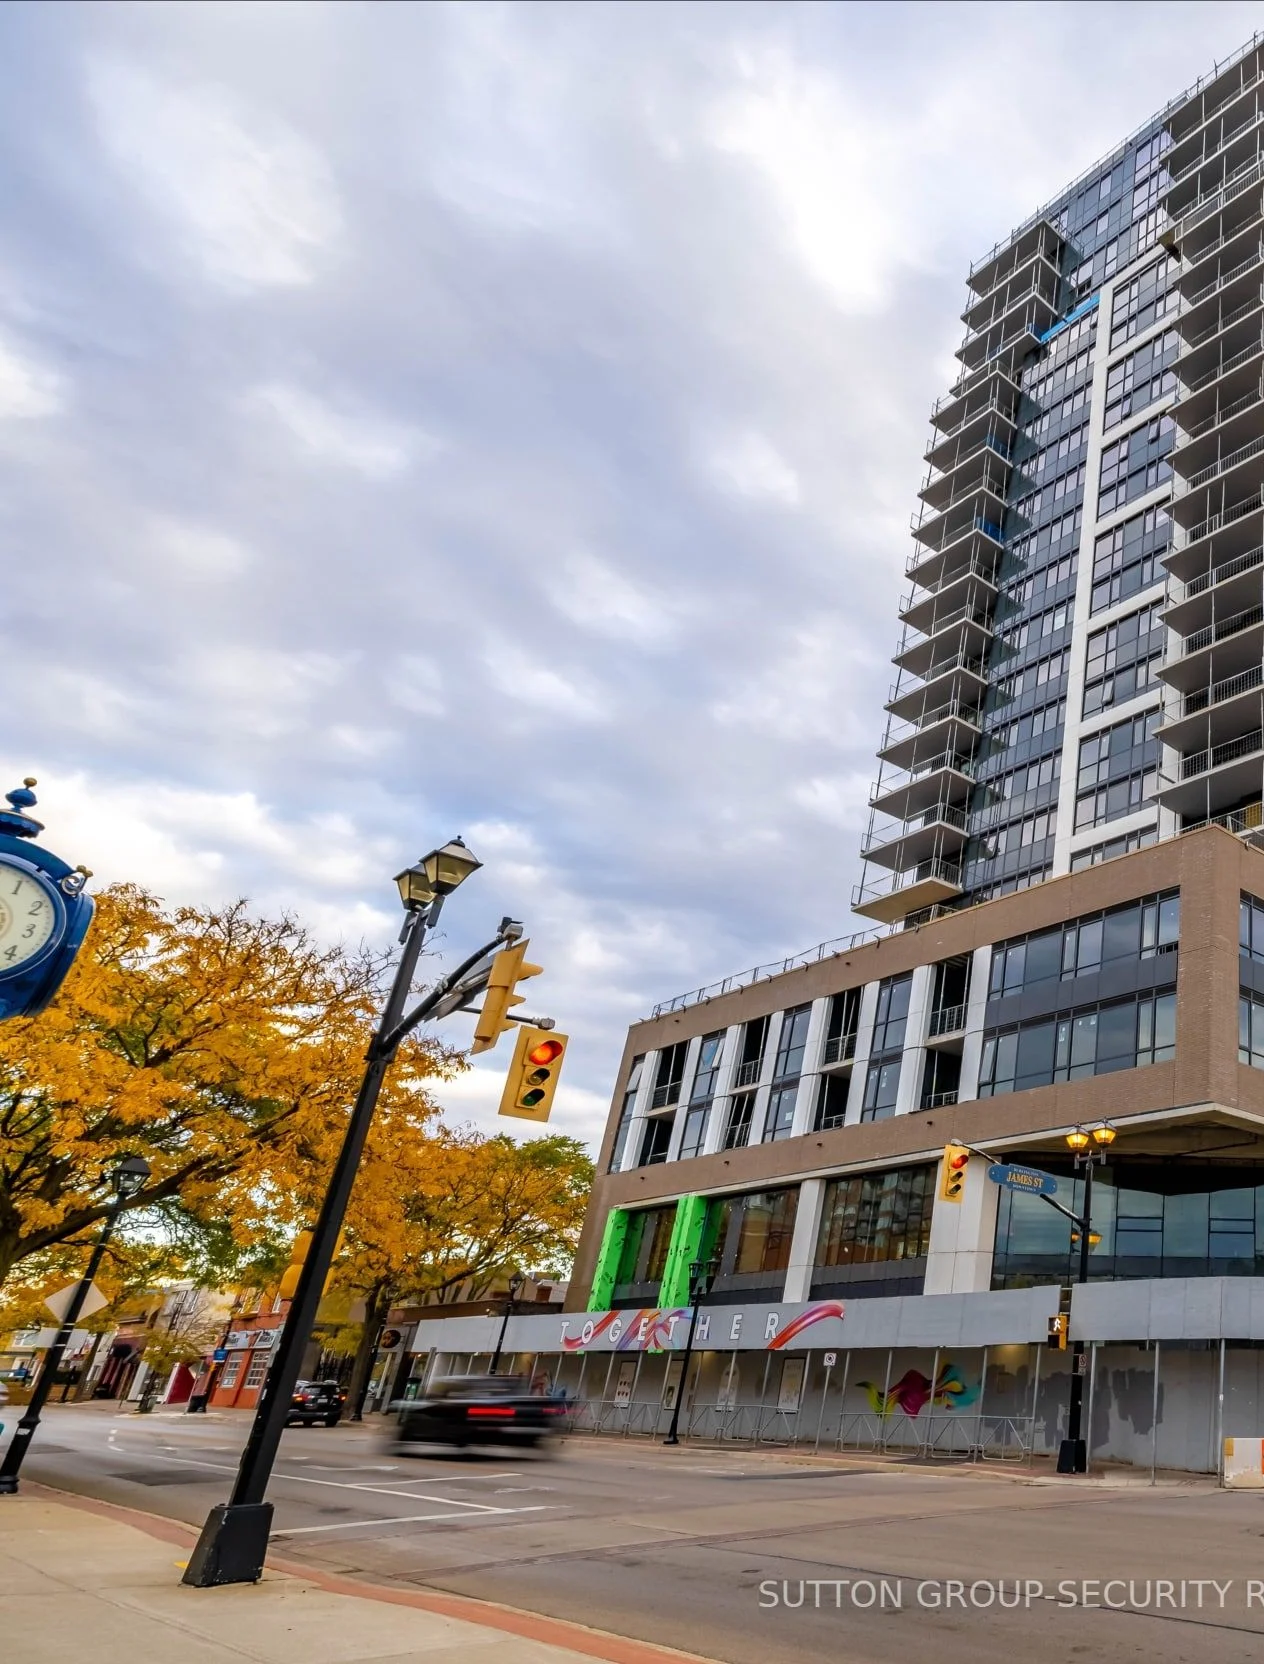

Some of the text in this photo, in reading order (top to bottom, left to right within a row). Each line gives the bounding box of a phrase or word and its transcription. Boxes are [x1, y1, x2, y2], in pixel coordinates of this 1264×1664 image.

[11, 880, 22, 895] 1
[28, 900, 44, 916] 2
[21, 923, 36, 938] 3
[3, 944, 17, 960] 4
[1007, 1171, 1044, 1189] JAMES ST
[560, 1312, 780, 1343] TOGETHER
